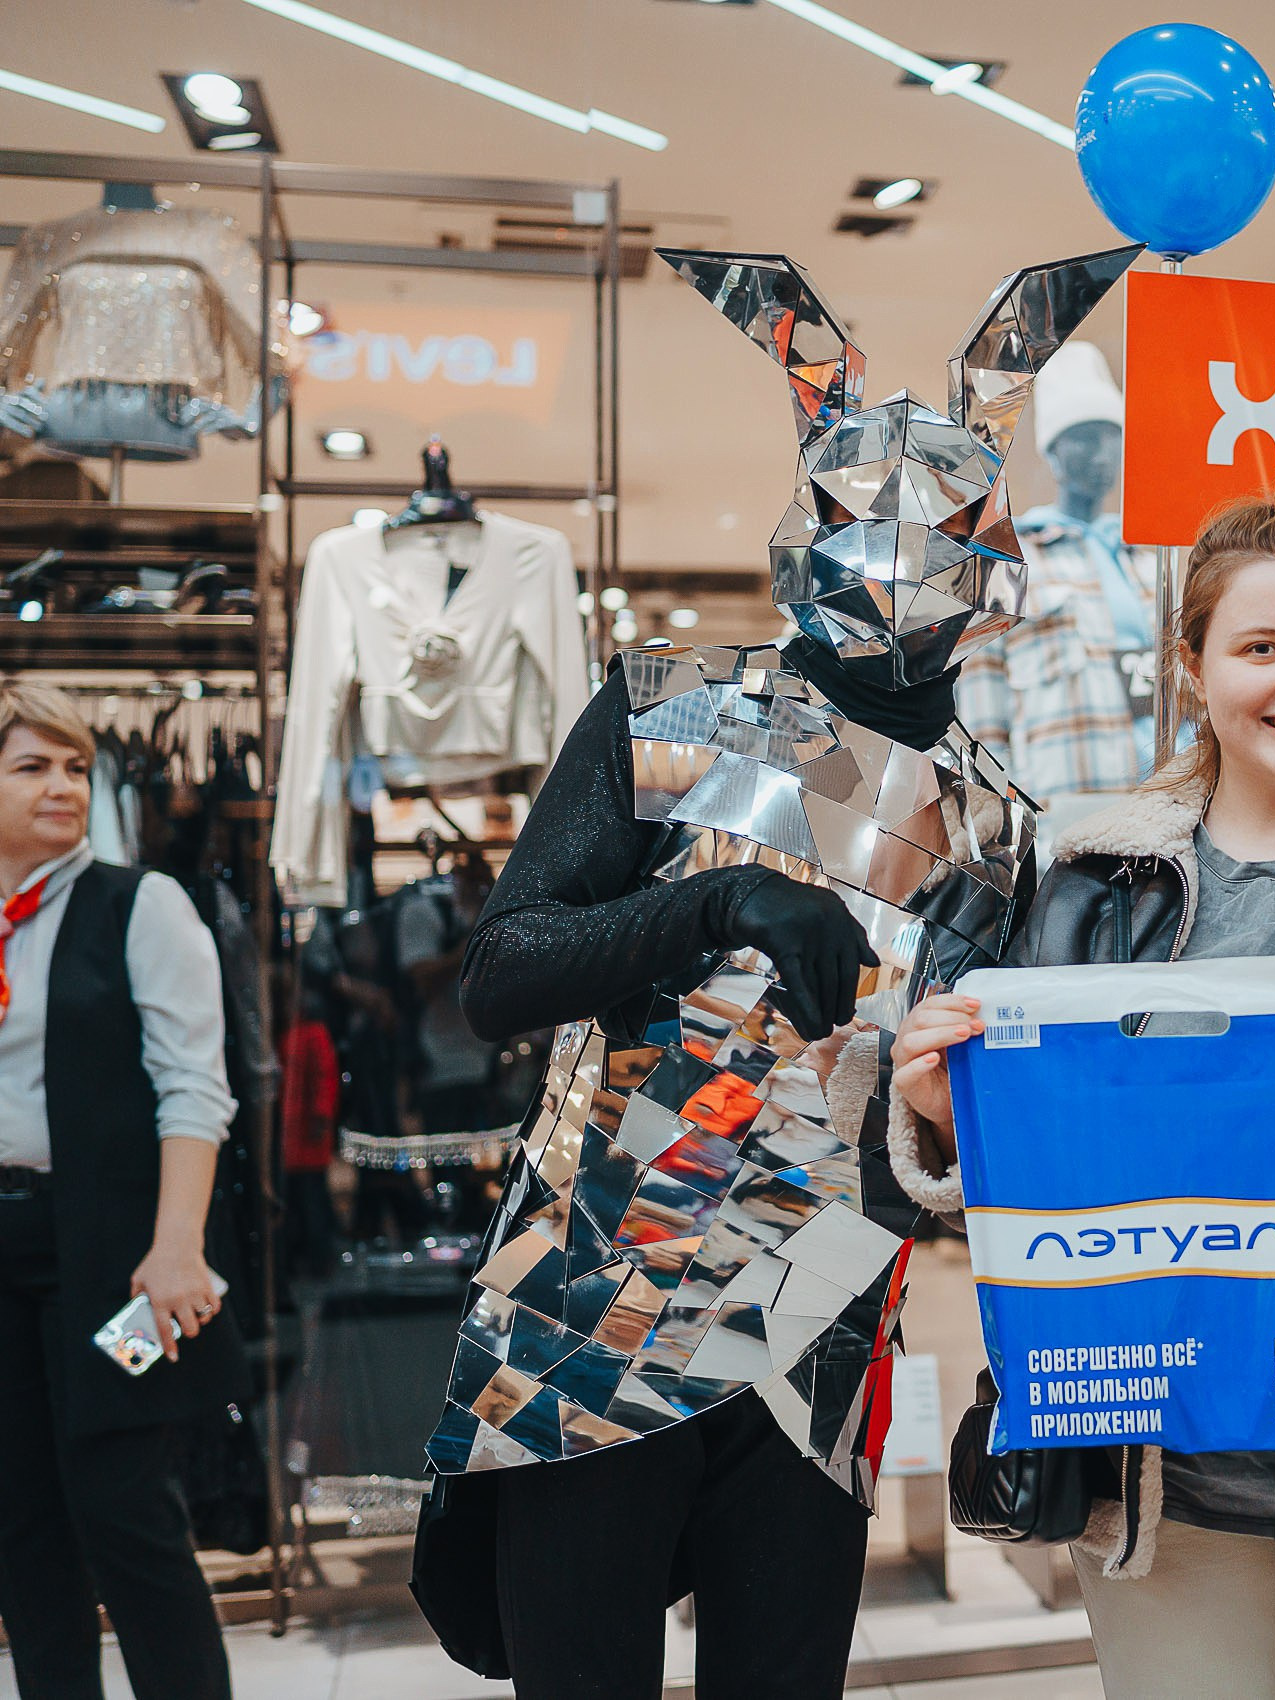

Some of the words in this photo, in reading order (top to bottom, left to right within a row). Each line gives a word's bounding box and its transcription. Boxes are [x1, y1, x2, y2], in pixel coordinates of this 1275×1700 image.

[1028, 1344, 1157, 1374] СОВЕРШЕННО
[1029, 1382, 1042, 1406] В
[1047, 1376, 1169, 1406] МОБИЛЬНОМ
[1030, 1408, 1163, 1438] ПРИЛОЖЕНИИ
